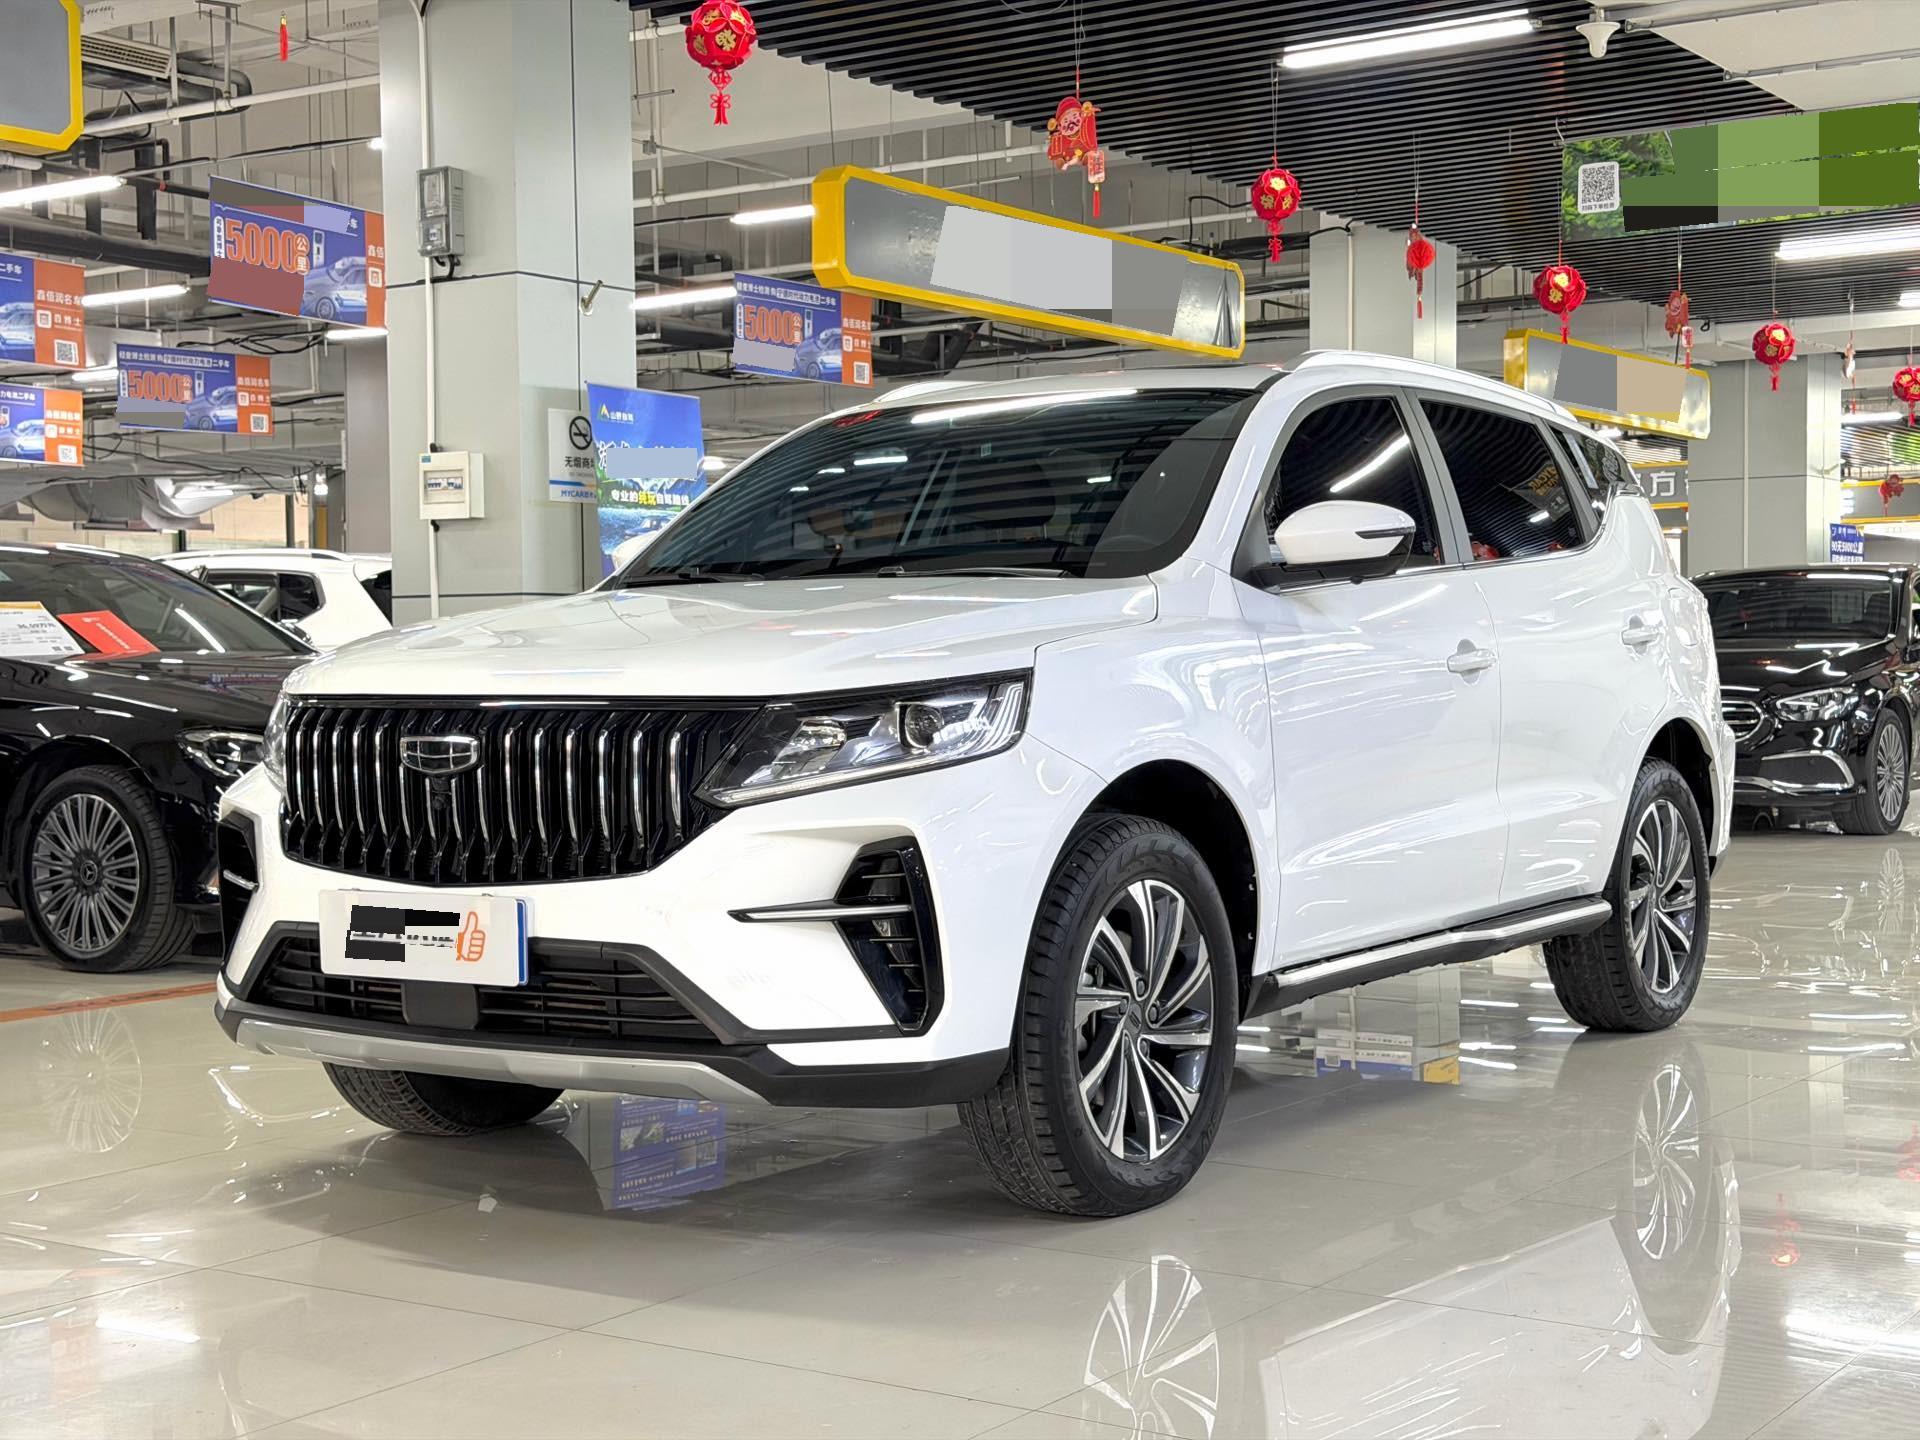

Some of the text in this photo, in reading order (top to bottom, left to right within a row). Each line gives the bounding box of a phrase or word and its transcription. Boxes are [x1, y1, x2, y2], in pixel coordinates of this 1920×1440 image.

[225, 217, 310, 275] 5000 公里
[744, 305, 795, 345] 5000
[128, 370, 184, 404] 5000
